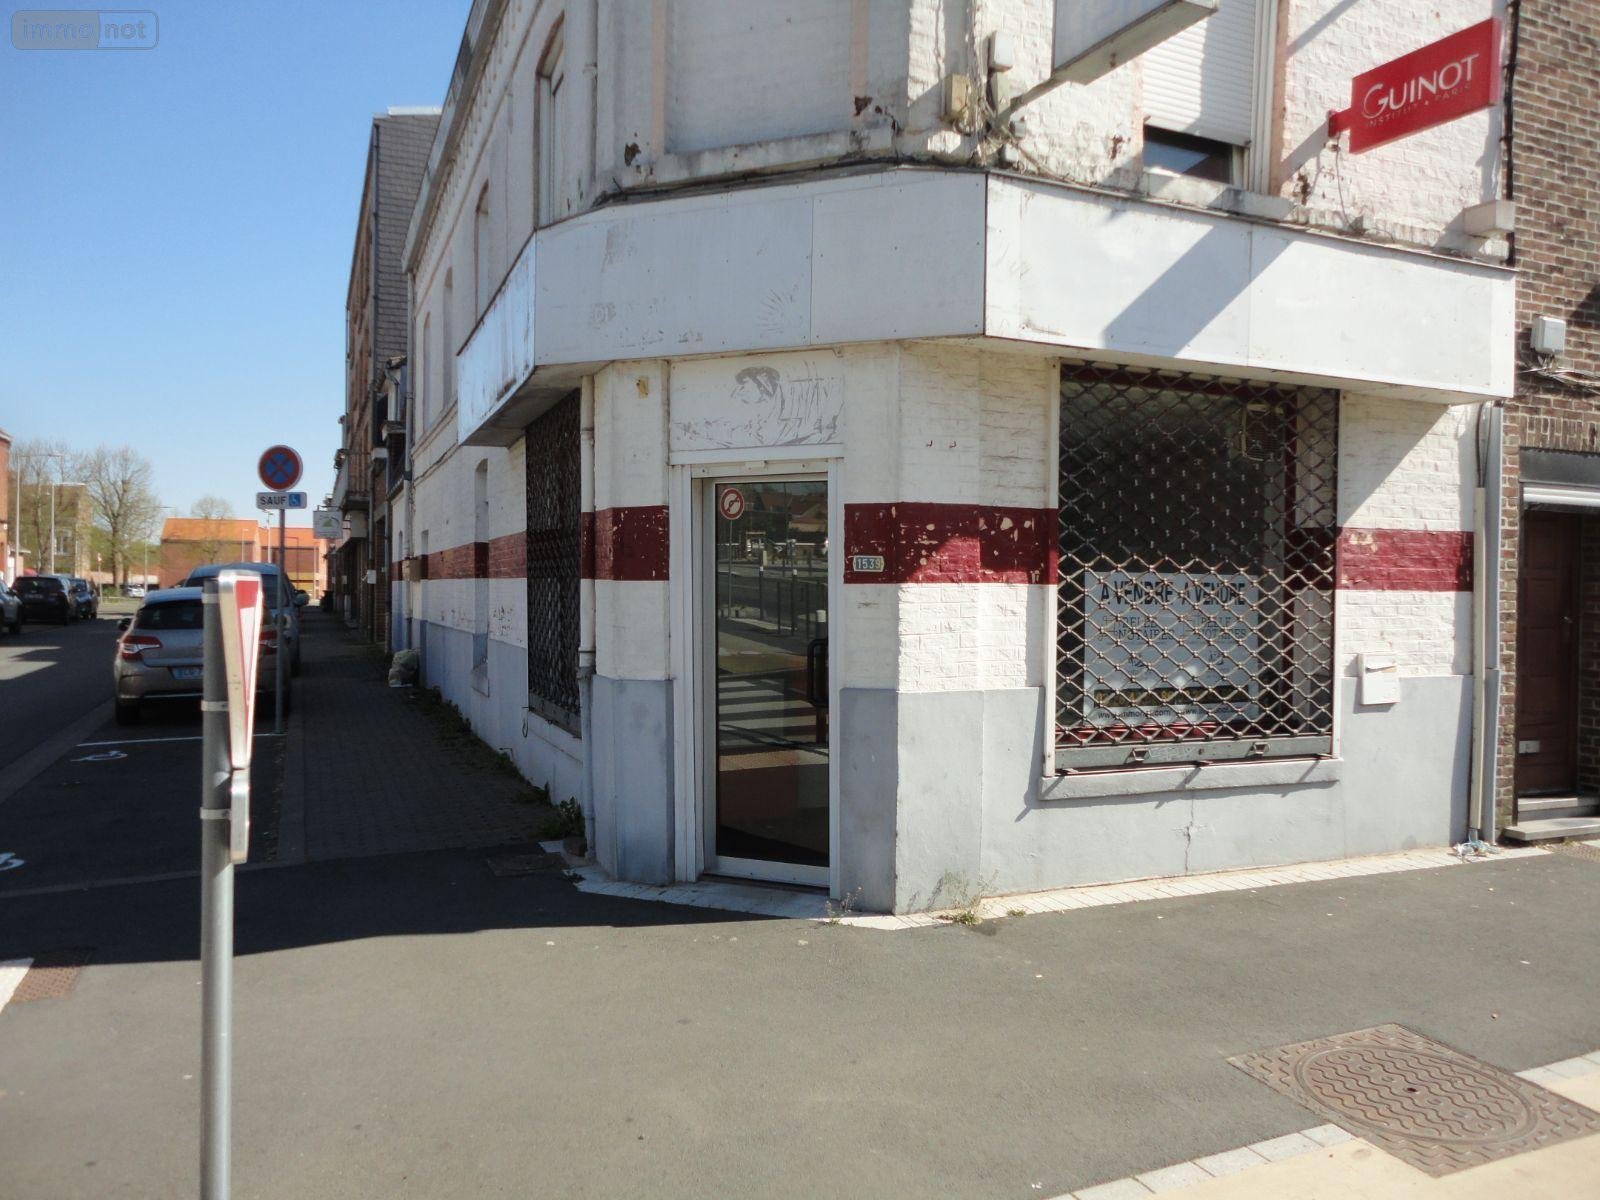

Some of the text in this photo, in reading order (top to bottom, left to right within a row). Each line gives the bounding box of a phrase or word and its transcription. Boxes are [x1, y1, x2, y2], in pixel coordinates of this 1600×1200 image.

[1362, 53, 1479, 119] GUINOT
[260, 496, 287, 506] SAUF
[1114, 581, 1174, 605] VENDRE
